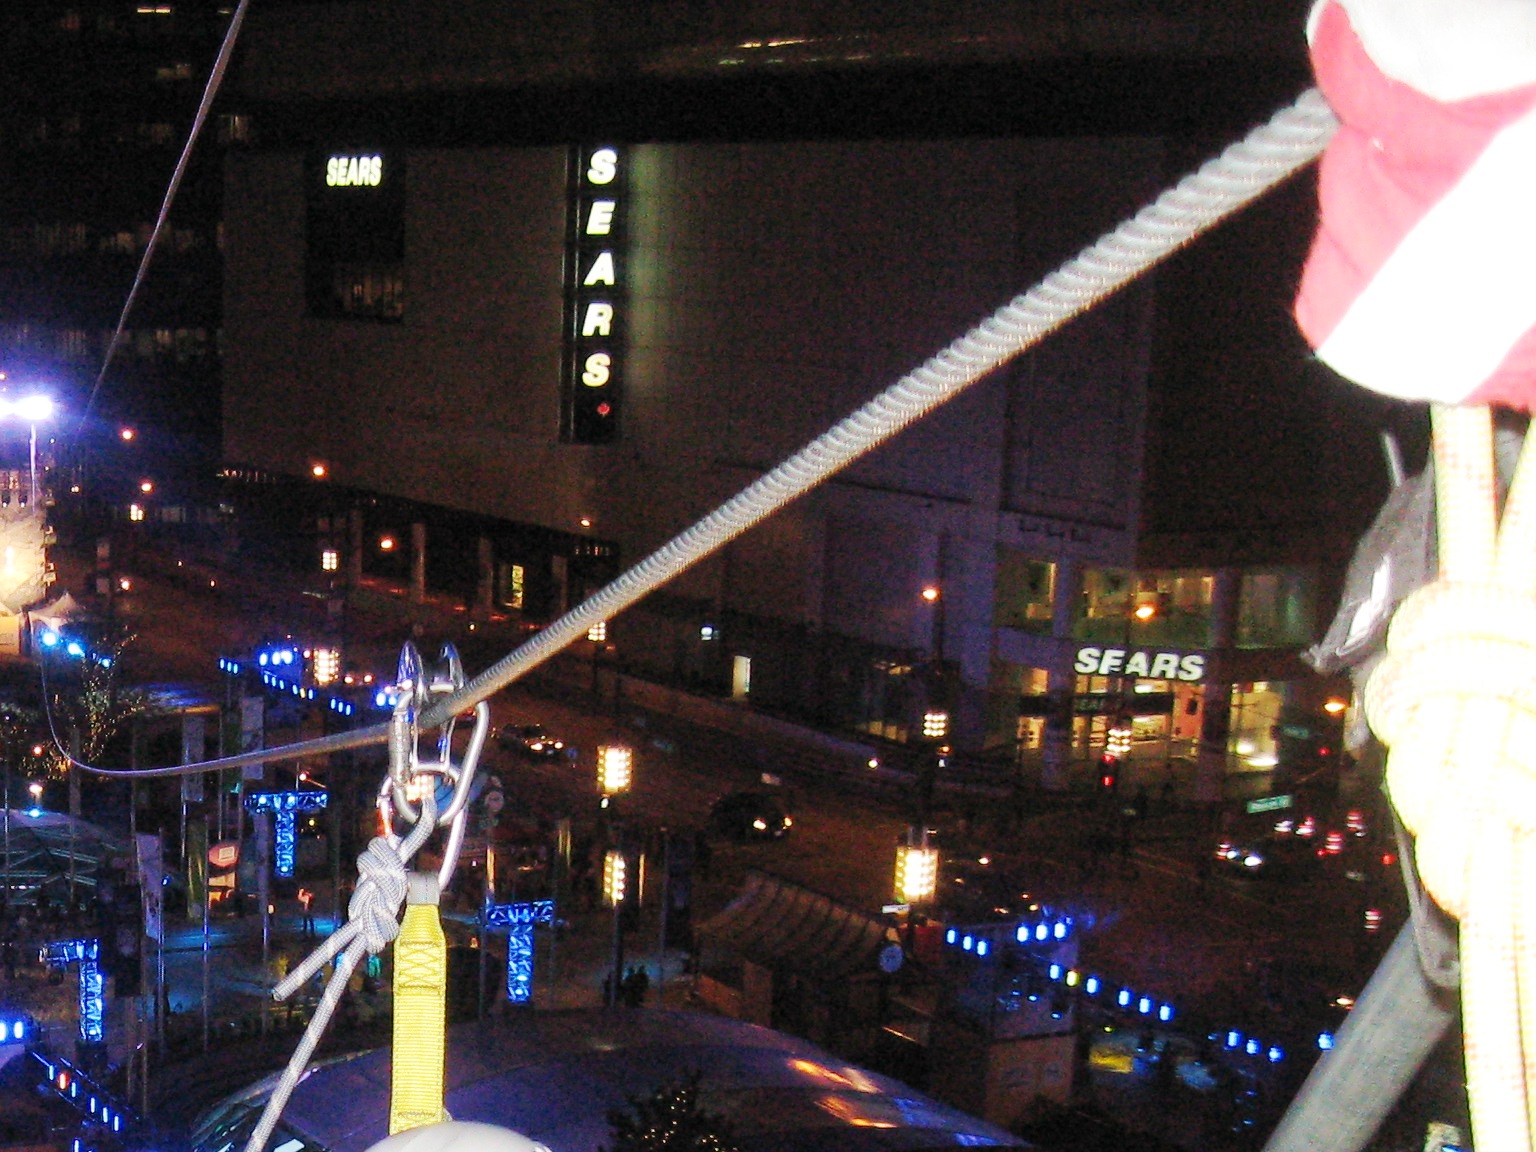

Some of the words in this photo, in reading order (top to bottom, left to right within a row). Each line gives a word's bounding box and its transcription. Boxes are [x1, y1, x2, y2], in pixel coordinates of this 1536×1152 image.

[325, 153, 383, 187] SEARS
[579, 147, 619, 388] SEARS
[1073, 646, 1206, 682] SEARS
